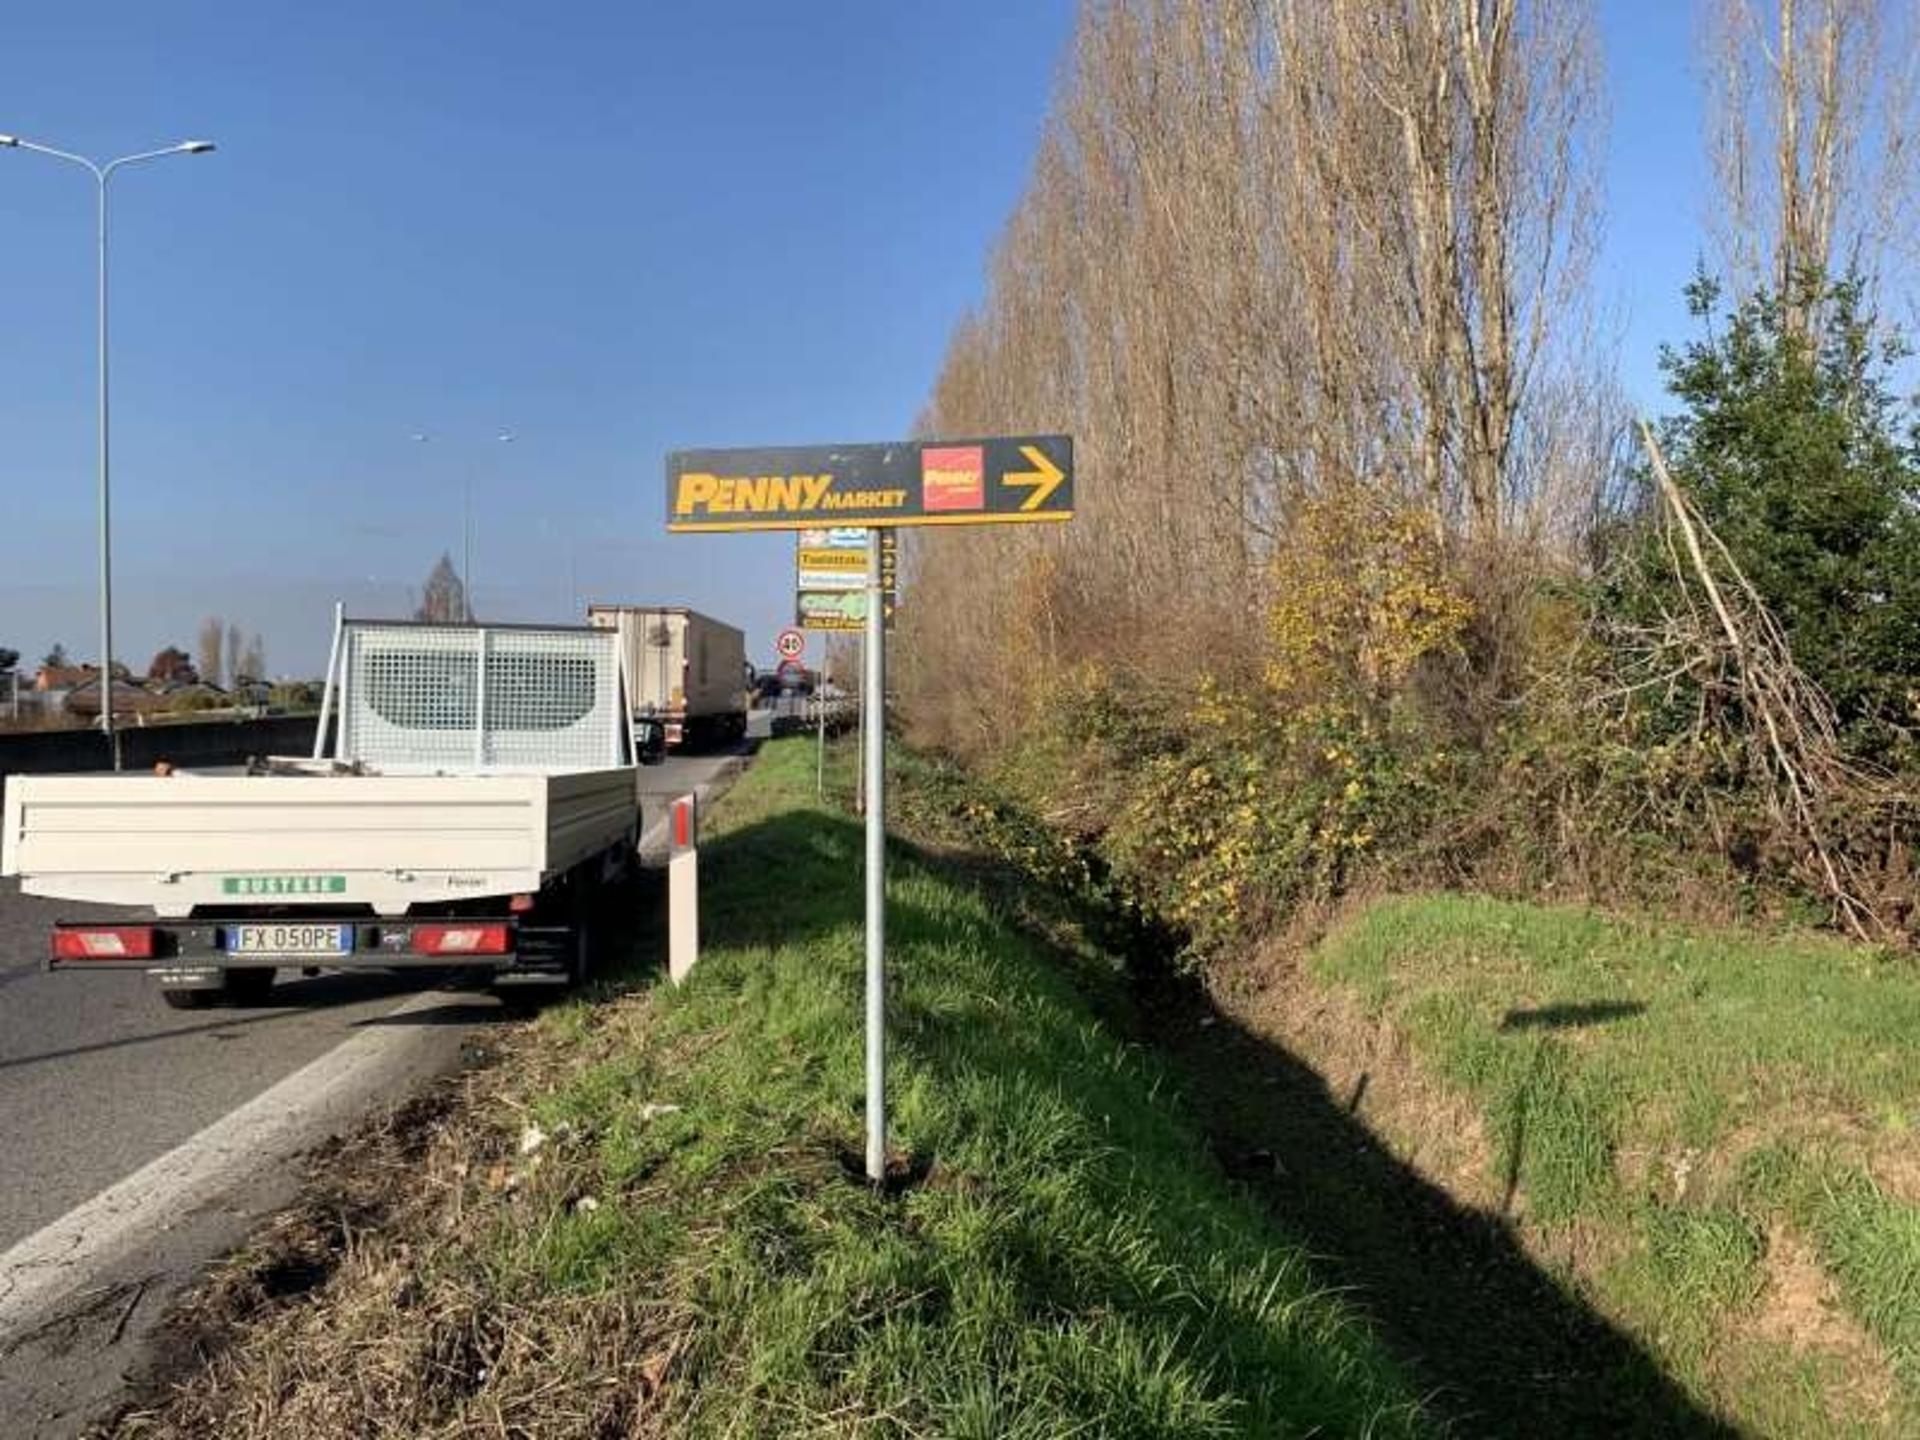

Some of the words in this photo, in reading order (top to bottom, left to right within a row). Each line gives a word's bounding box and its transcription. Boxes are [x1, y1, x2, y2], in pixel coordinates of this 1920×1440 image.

[676, 473, 833, 514] PENNY
[821, 489, 907, 509] MARKET
[783, 638, 800, 651] 40
[242, 928, 265, 947] FX
